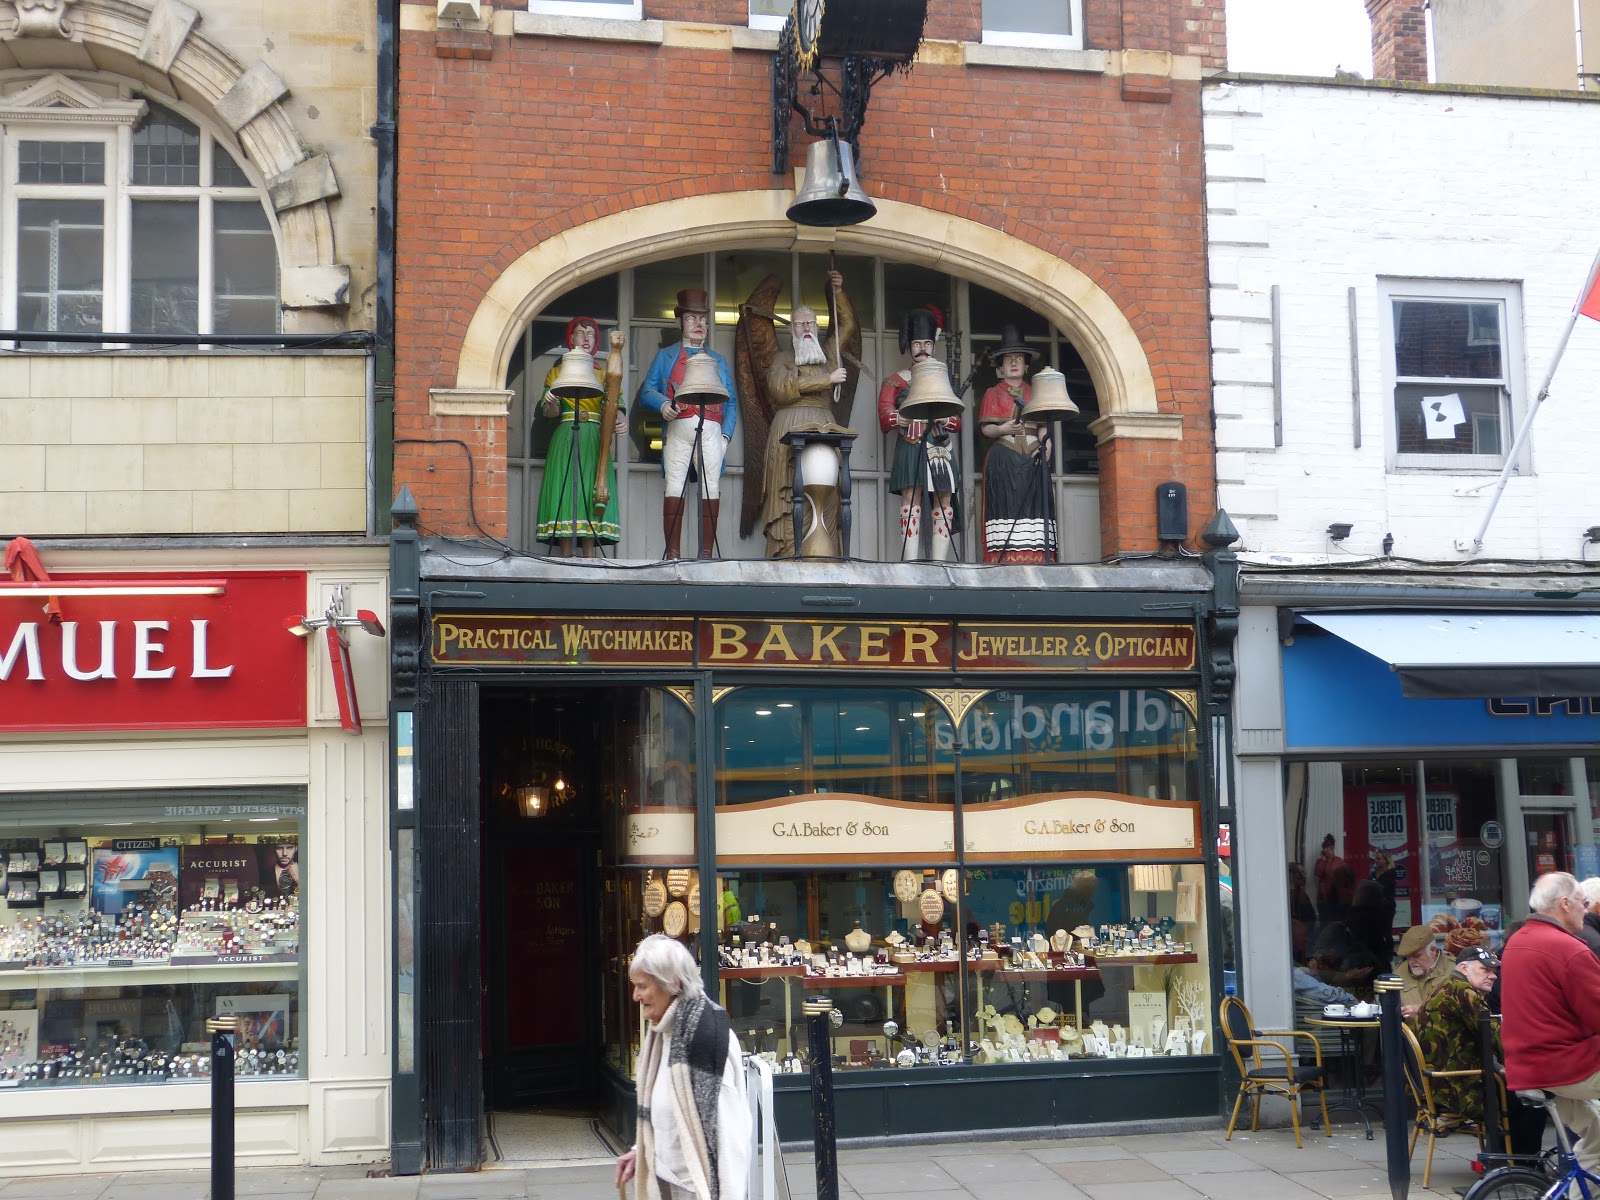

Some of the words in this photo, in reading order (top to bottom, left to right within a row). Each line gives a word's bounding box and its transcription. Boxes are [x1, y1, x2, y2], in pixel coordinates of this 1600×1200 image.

[438, 623, 558, 656] PRACTICAL
[561, 623, 694, 657] WATCHMAKER
[709, 623, 940, 663] BAKER
[957, 631, 1068, 662] JEWELLER
[1071, 634, 1092, 656] &
[1095, 631, 1188, 661] OPTICIAN
[845, 821, 859, 836] &
[862, 820, 890, 836] Son
[1094, 819, 1107, 833] &
[1109, 818, 1136, 833] Son
[116, 840, 156, 849] CITIZEN
[1458, 850, 1472, 859] WE
[190, 860, 248, 869] ACCURIST
[1445, 866, 1473, 874] BAKED
[1448, 874, 1473, 882] THESE
[217, 955, 264, 963] ACCURIST
